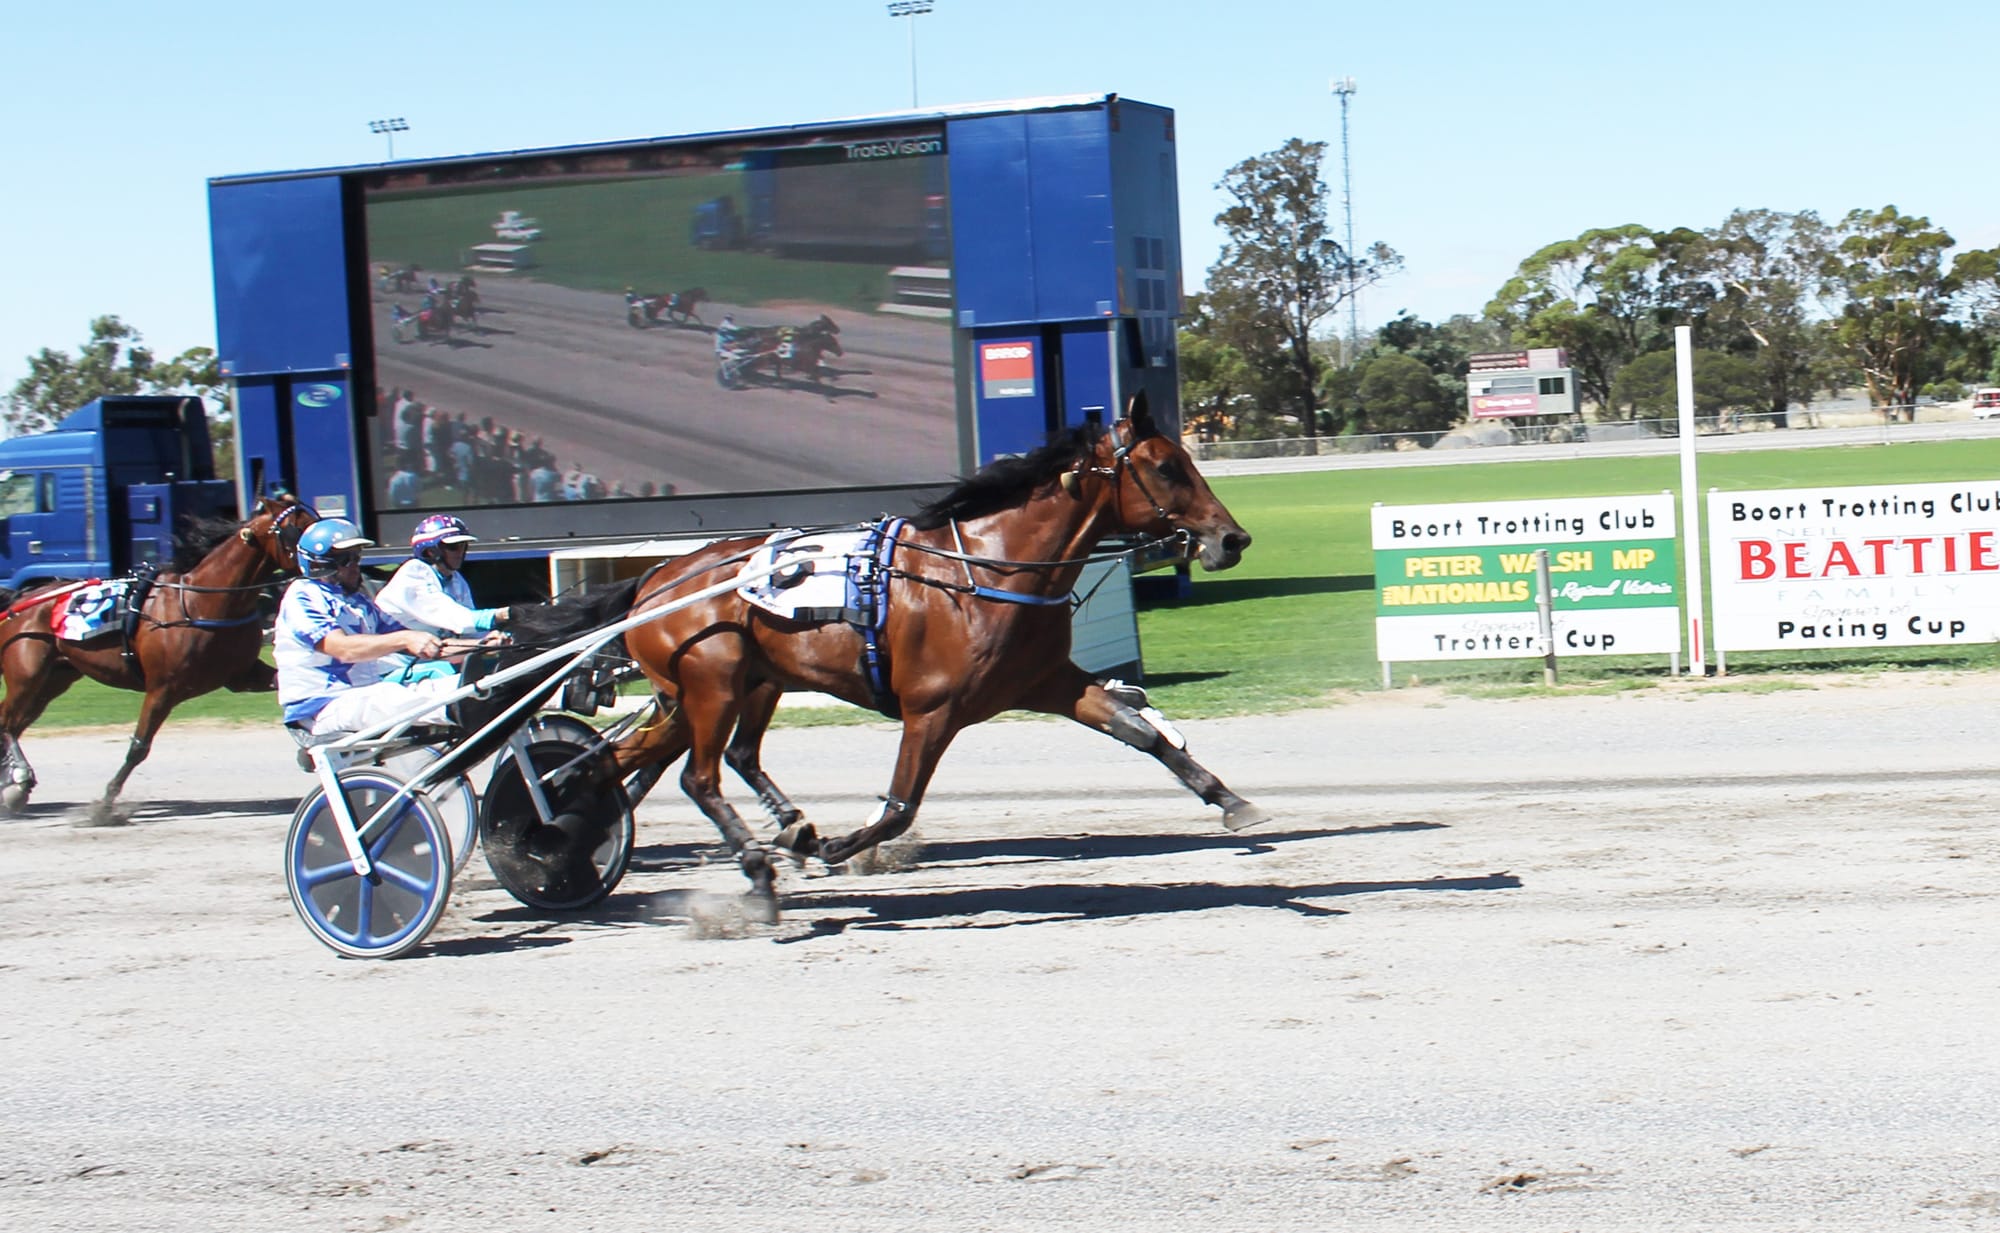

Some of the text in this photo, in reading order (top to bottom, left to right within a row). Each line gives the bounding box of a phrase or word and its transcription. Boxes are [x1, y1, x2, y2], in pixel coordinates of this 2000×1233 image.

[843, 140, 942, 159] TrotsVision
[1732, 490, 2000, 521] Boort Trotting Club
[1392, 509, 1655, 538] Boort Trotting Club
[1776, 527, 1845, 538] NEIL
[1405, 555, 1483, 578] PETER
[1612, 548, 1655, 571] MP
[1738, 531, 2000, 581] BEATTIE
[1391, 580, 1529, 605] NATIONALS
[1779, 584, 1960, 602] FAMILY
[1778, 615, 1965, 640] Pacing Cup
[1434, 629, 1615, 652] Trotter Cup
